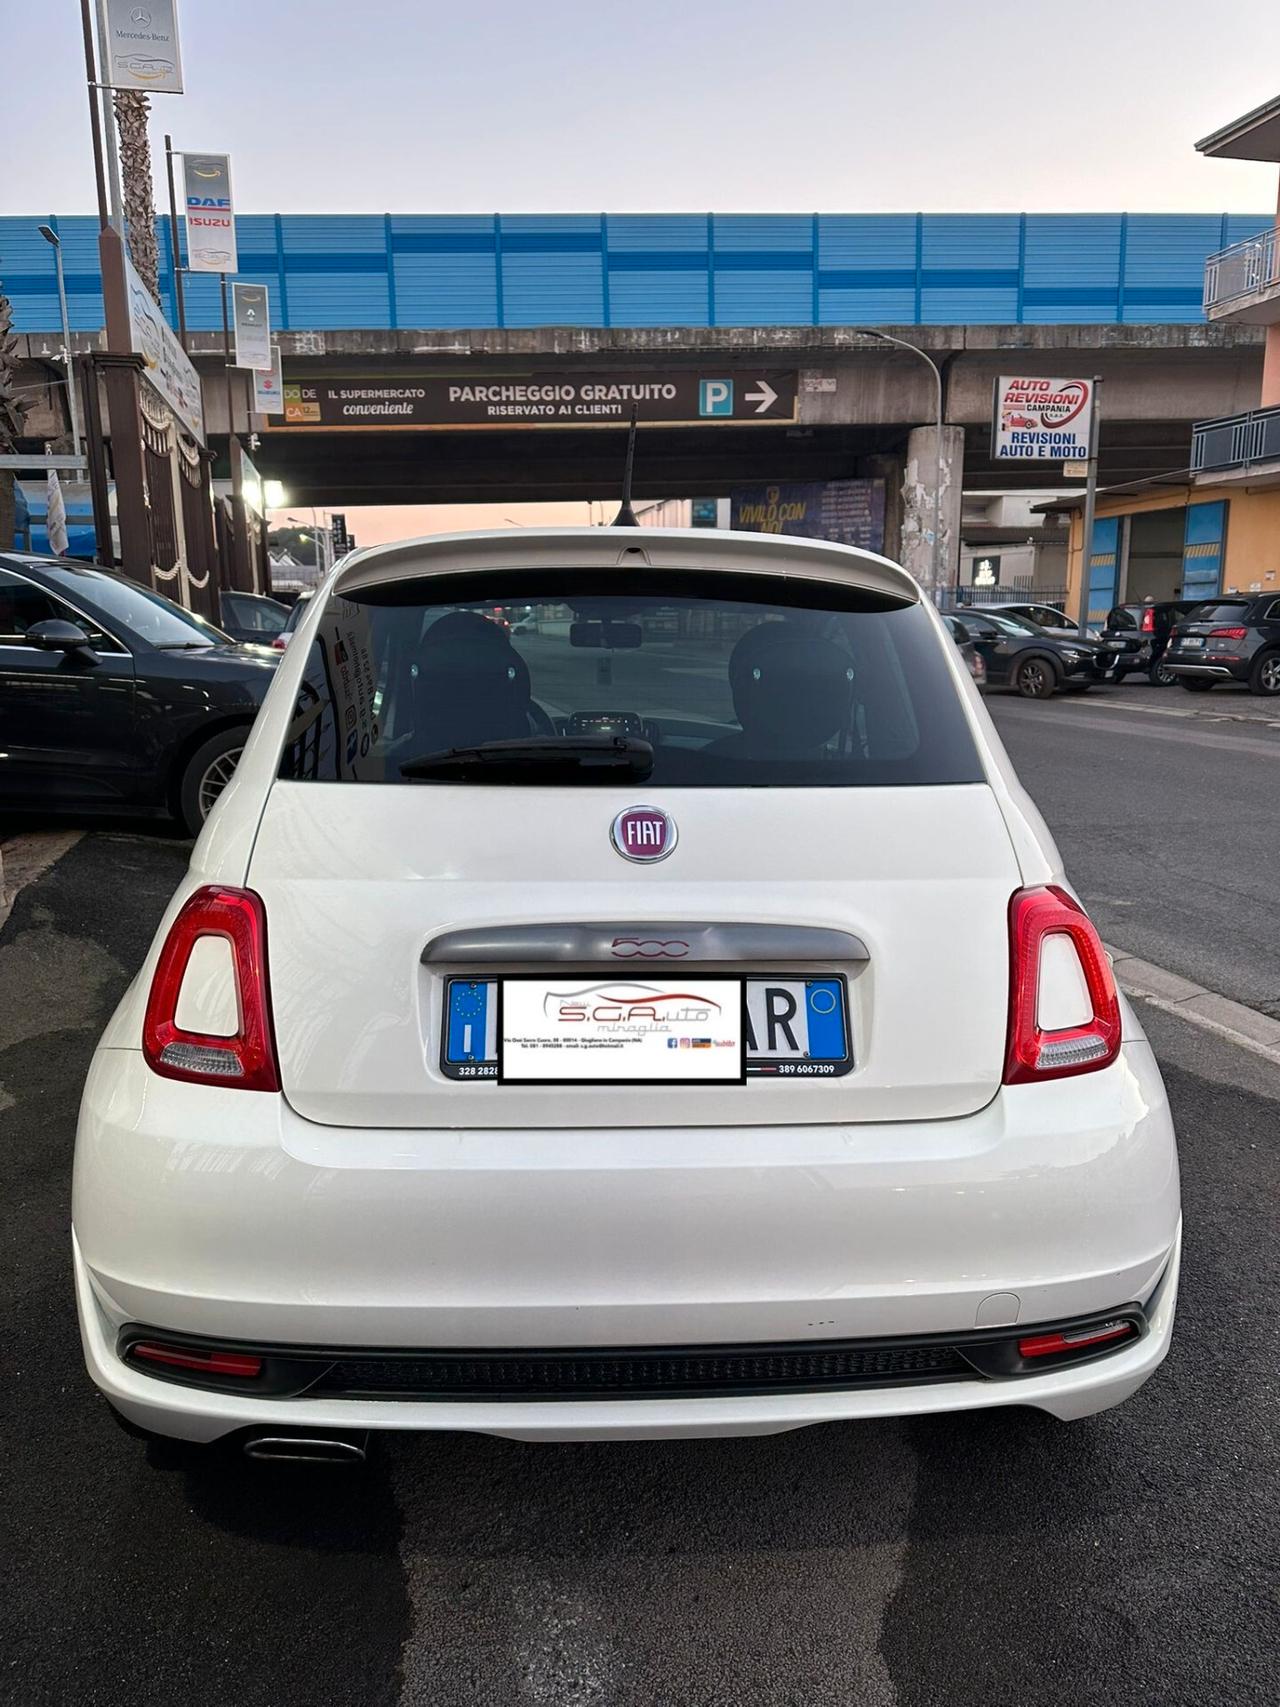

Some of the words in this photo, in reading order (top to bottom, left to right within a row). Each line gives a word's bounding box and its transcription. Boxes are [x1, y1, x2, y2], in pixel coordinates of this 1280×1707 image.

[116, 30, 169, 41] Mercedes-Benz
[187, 197, 230, 207] DAF
[190, 217, 230, 227] ISUZU
[1009, 380, 1051, 391] AUTO
[328, 390, 338, 399] IL
[340, 389, 426, 399] SUPERMERCATO
[449, 385, 576, 401] PARCHEGGIO
[580, 383, 677, 400] GRATUITO
[706, 382, 728, 413] P
[1004, 392, 1080, 405] REVISIONI
[343, 402, 414, 415] conveniente
[488, 405, 555, 415] RISERVATO
[559, 405, 571, 415] AI
[575, 404, 622, 414] CLIENTI
[1026, 404, 1071, 413] CAMPANIA
[1011, 432, 1076, 444] REVISIONI
[1000, 445, 1034, 457] AUTO
[1038, 446, 1046, 457] E
[1050, 446, 1087, 458] MOTO
[779, 502, 806, 520] CON
[627, 821, 663, 845] FIAT
[611, 937, 690, 957] 500
[459, 1067, 476, 1075] 328
[779, 1065, 795, 1073] 389
[797, 1065, 834, 1073] 6067309
